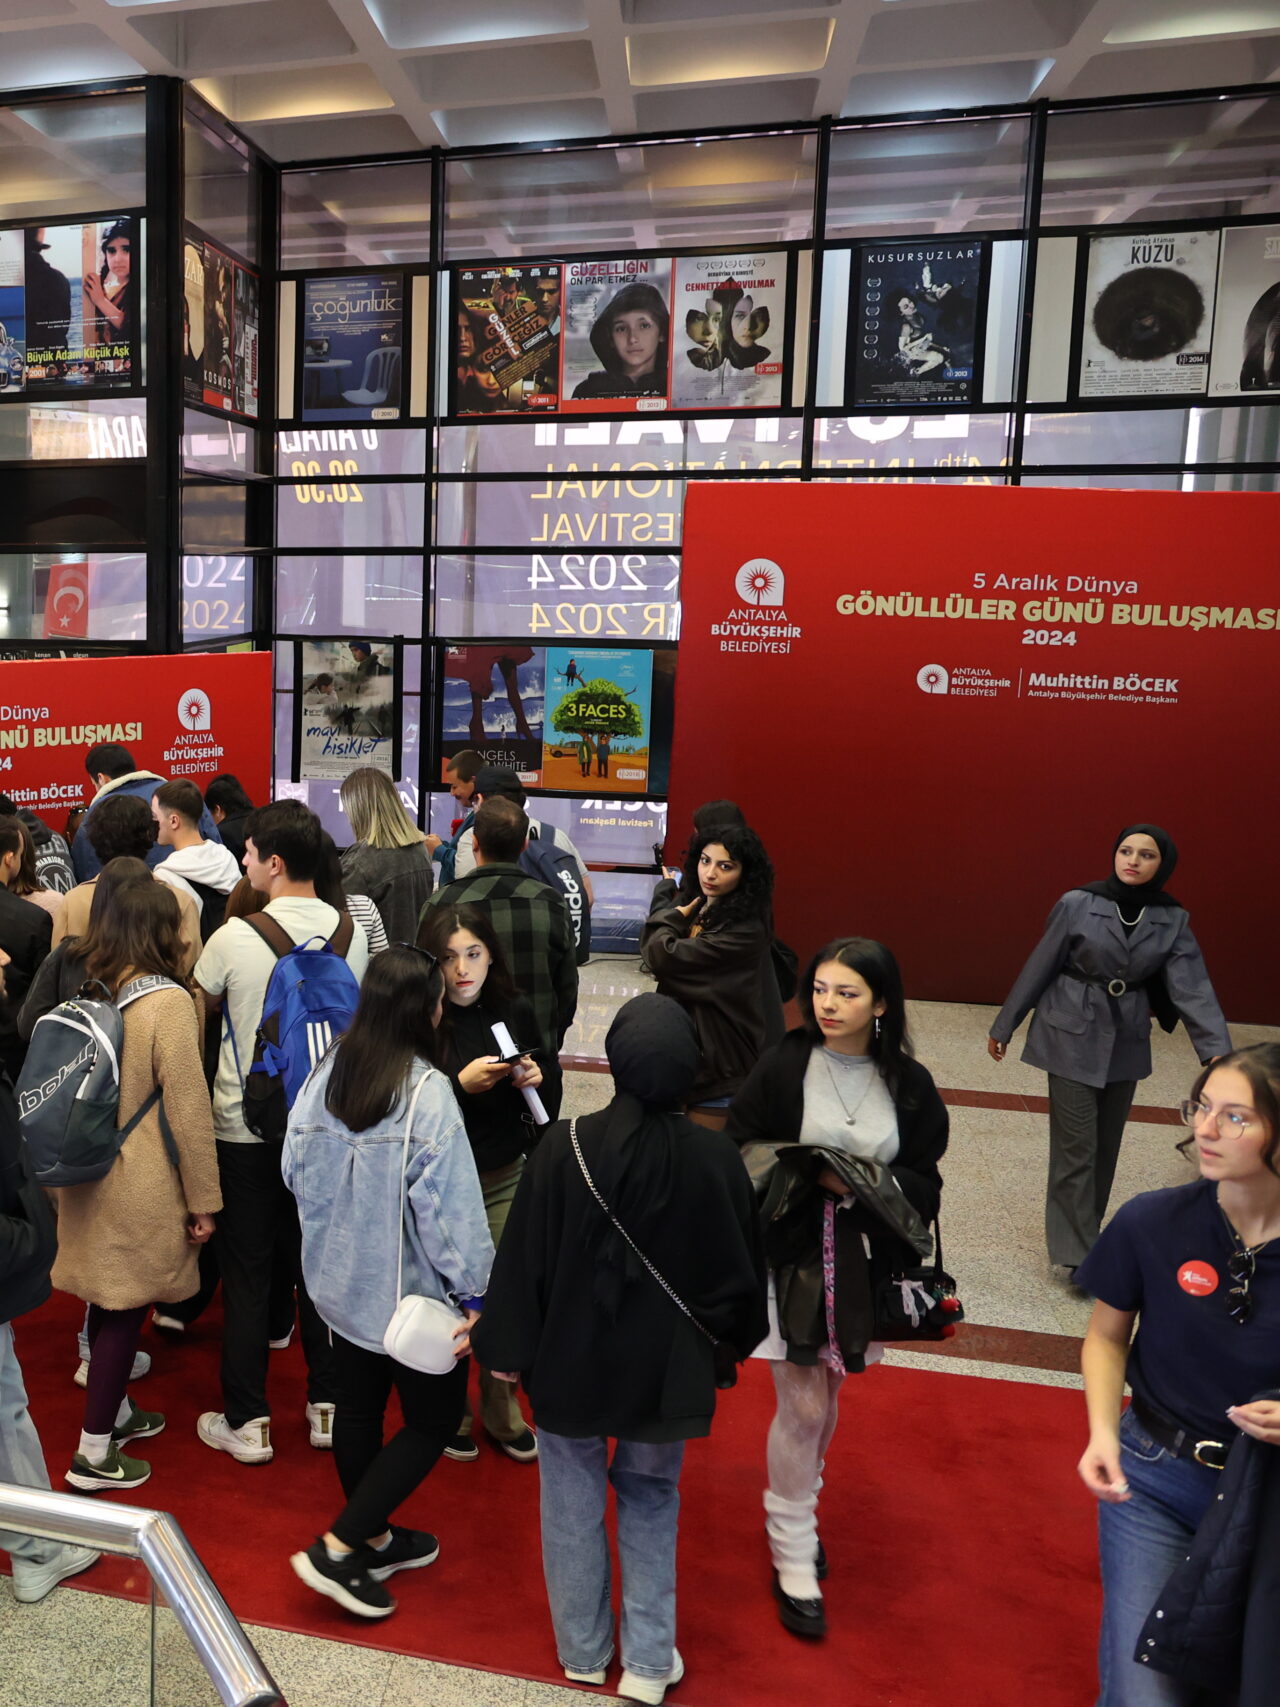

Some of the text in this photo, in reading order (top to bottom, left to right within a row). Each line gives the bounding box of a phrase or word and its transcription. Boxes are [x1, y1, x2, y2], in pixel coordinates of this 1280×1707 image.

[867, 249, 974, 263] KUSURSUZLAR
[1130, 244, 1175, 265] KUZU
[185, 258, 205, 286] ZAR
[570, 277, 583, 286] ON
[608, 274, 637, 284] ETMEZ
[312, 289, 396, 324] çoğunluk
[26, 350, 55, 364] Büyük
[55, 349, 82, 361] Adam
[83, 347, 112, 360] Küçük
[112, 345, 130, 358] Aşk
[29, 369, 46, 377] 2001
[203, 369, 231, 391] KOSMOS
[183, 555, 246, 588] 024
[972, 573, 1139, 596] 5 Aralık Dünya
[727, 608, 788, 621] ANTALYA
[835, 590, 1017, 621] GÖNÜLLÜLER
[1022, 597, 1105, 624] GÜNÜ
[710, 621, 802, 639] BÜYÜKŞEHİR
[1021, 628, 1077, 646] 2024
[719, 639, 791, 654] BELEDİYESİ
[952, 667, 992, 677] ANTALYA
[951, 677, 1011, 688] BÜYÜKŞEHİR
[1028, 672, 1179, 693] Muhittin BÖCEK
[950, 687, 997, 697] BELEDİYESİ
[1027, 689, 1179, 704] Antalya Büyükşehir Belediye Başkanı
[0, 704, 50, 724] Dünya
[567, 703, 627, 719] 3 FACES
[33, 721, 143, 748] BULUŞMASI
[174, 733, 215, 746] ANTALYA
[306, 725, 341, 738] mavi
[163, 744, 224, 761] BÜYÜKŞEHİR
[321, 736, 392, 759] bisiklet
[170, 759, 219, 775] BELEDİYESİ
[39, 783, 84, 800] BÖCEK
[35, 801, 62, 811] Belediye
[35, 855, 65, 868] WARRIORS
